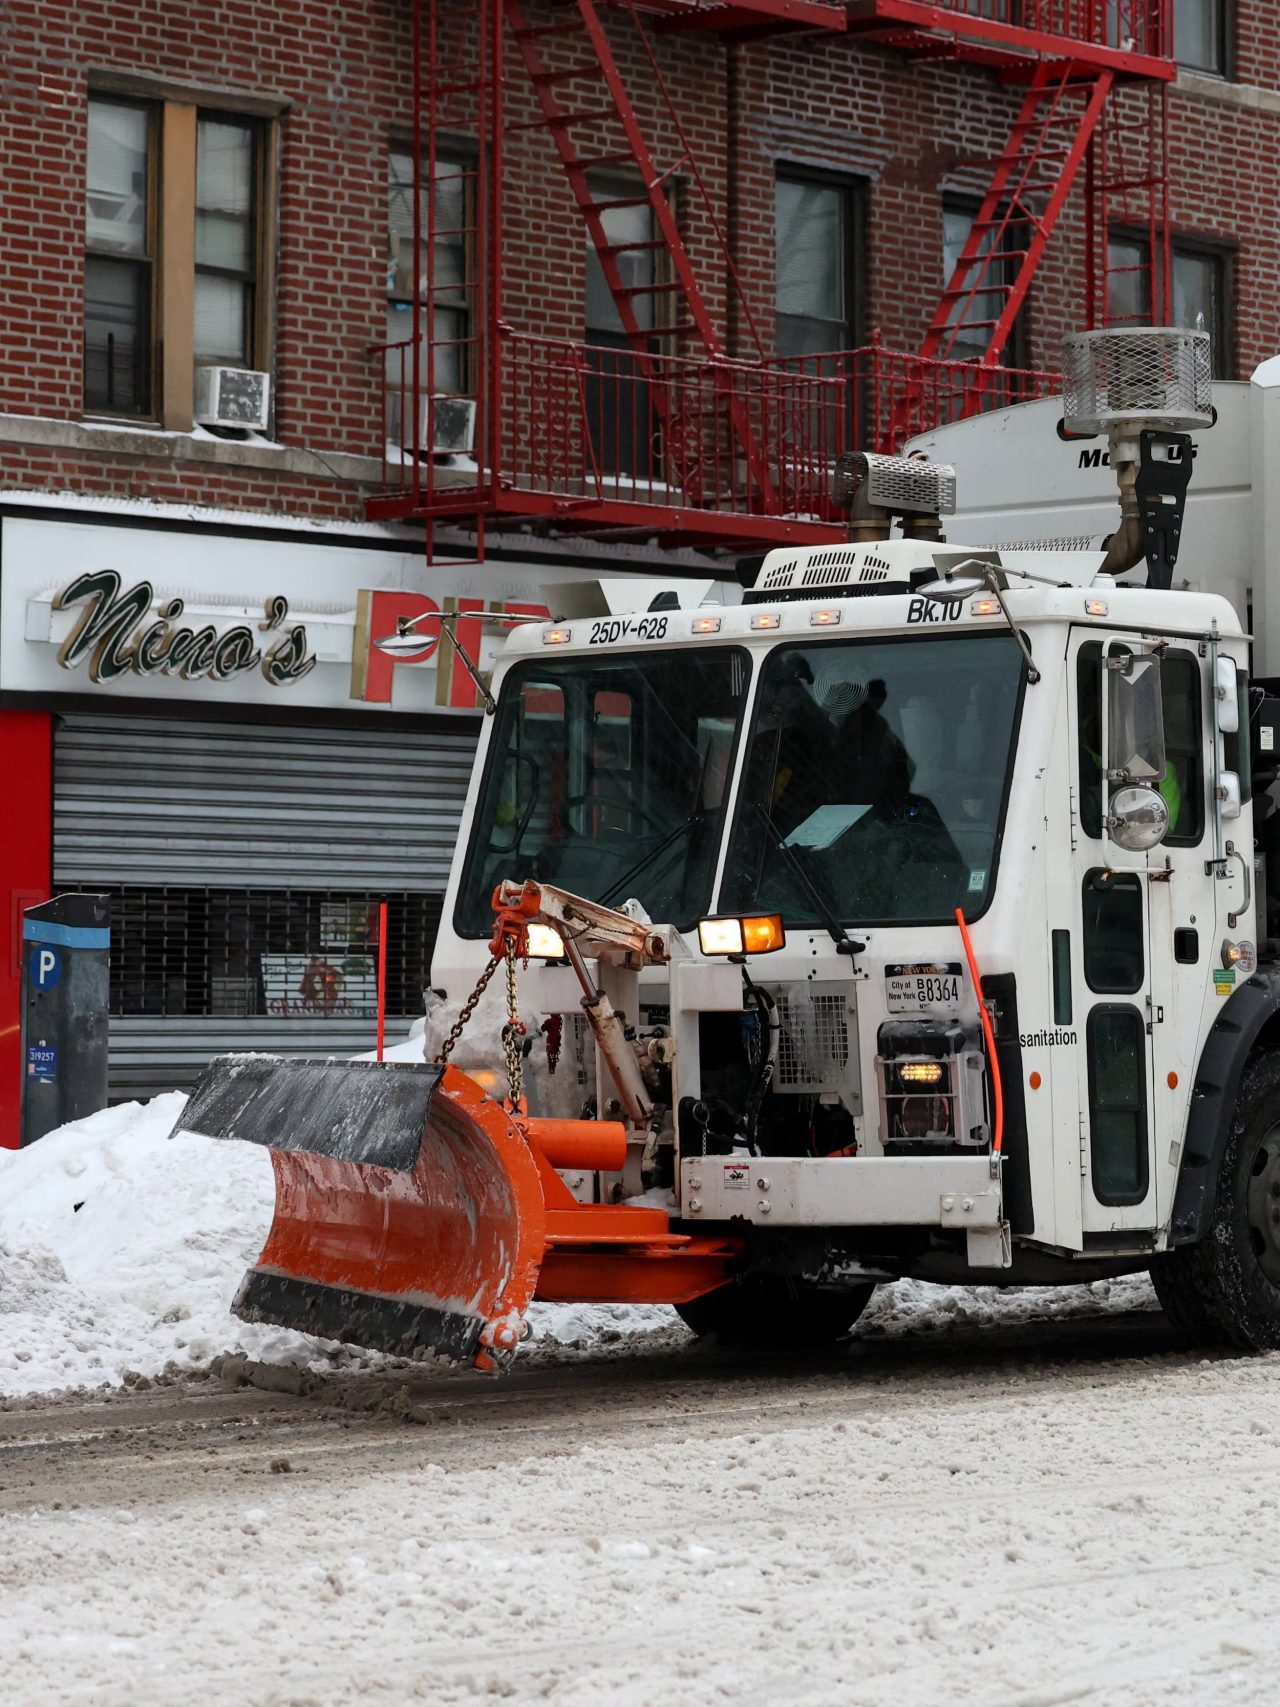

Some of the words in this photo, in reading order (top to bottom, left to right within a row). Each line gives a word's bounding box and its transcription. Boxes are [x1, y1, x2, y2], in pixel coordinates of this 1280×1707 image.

[52, 570, 316, 687] Nino's
[589, 617, 668, 644] 25DY-628
[40, 951, 55, 984] P
[888, 992, 901, 1000] New
[902, 992, 916, 1000] York
[892, 981, 903, 990] City
[904, 981, 911, 989] of
[926, 977, 958, 1001] 8364
[1020, 1028, 1077, 1048] sanitation
